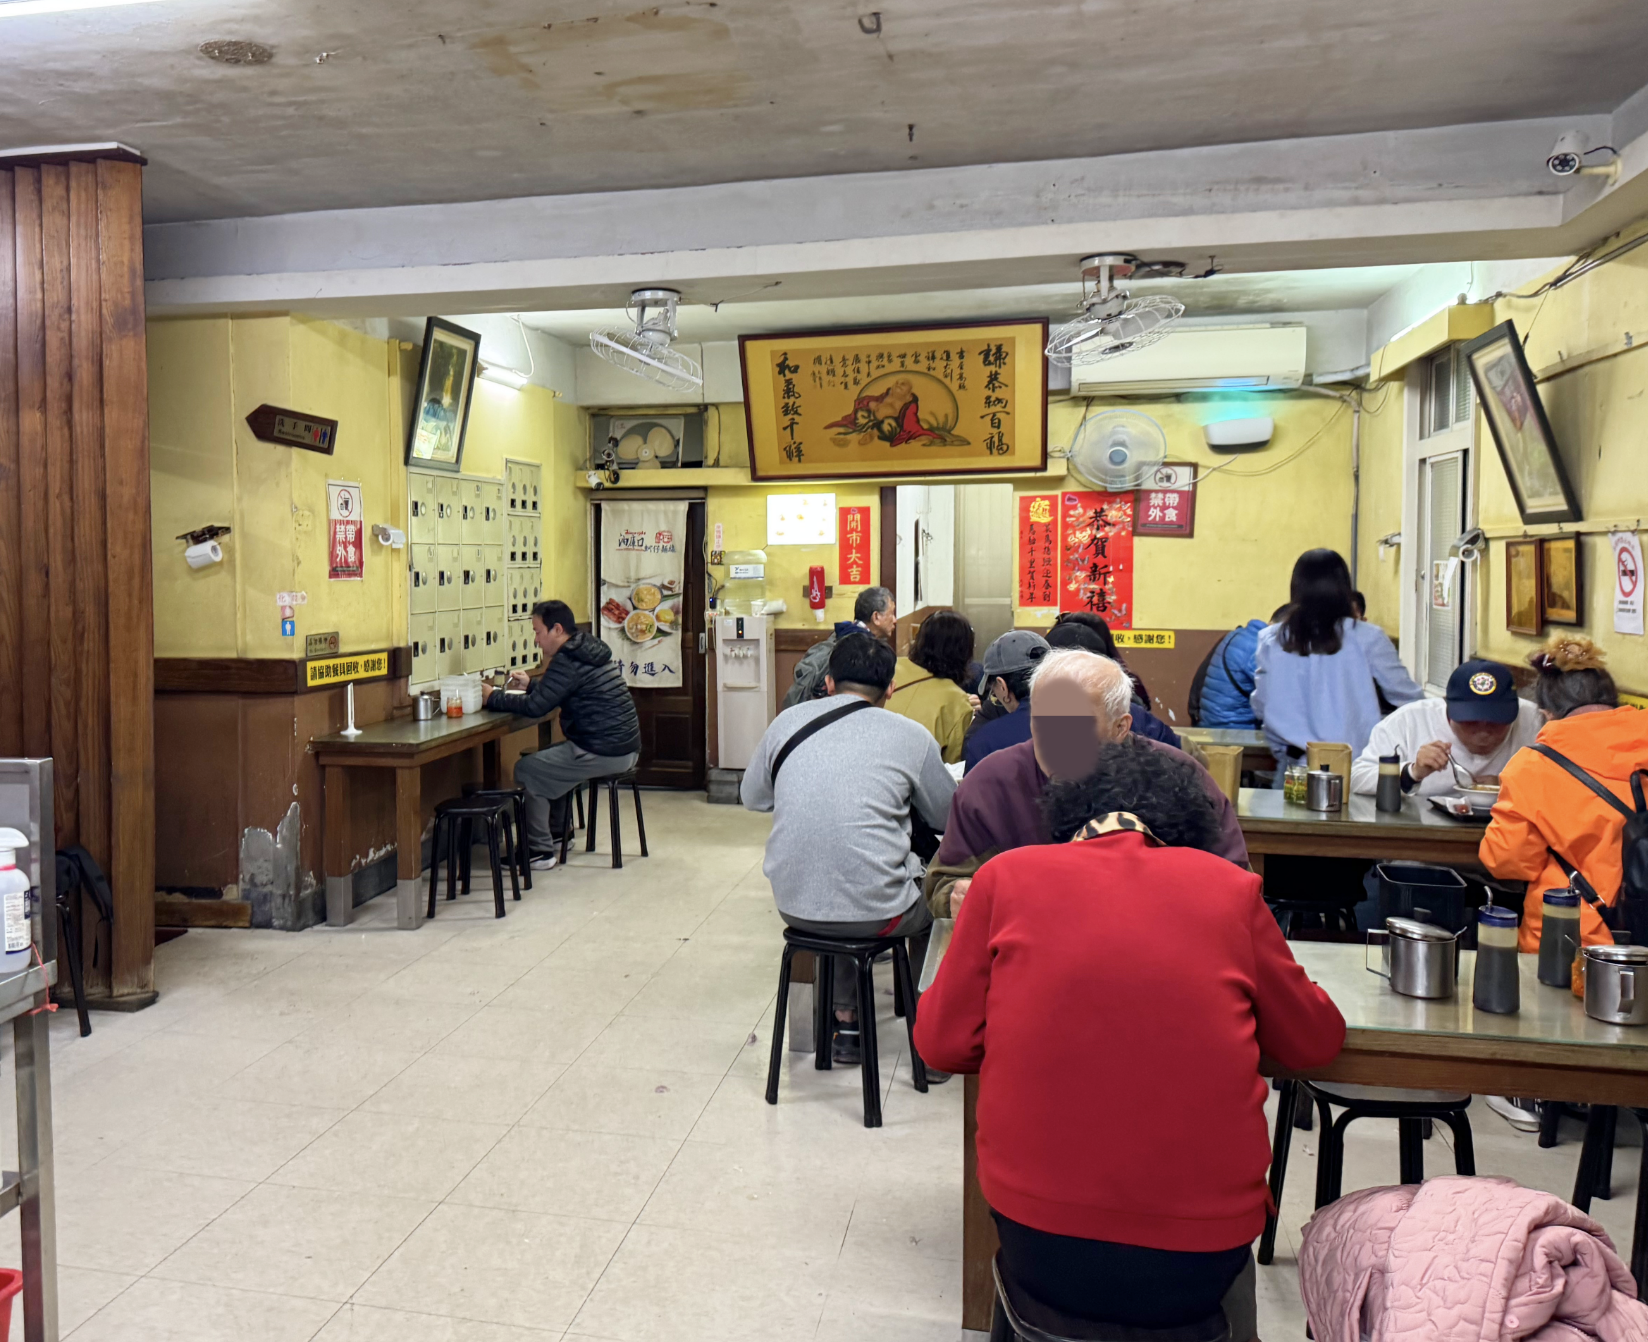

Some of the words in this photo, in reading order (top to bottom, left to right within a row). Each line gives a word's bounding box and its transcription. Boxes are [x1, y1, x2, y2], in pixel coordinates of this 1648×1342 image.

[776, 352, 805, 464] 和氣致千祥
[978, 343, 1010, 457] 謙恭納百福
[1149, 492, 1179, 506] 禁帶
[1148, 507, 1179, 522] 外食
[336, 524, 356, 543] 禁帶
[336, 544, 356, 563] 外食
[846, 513, 864, 583] 開市大吉
[1085, 507, 1114, 613] 恭賀新禧
[1111, 633, 1172, 644] 收，感謝您！
